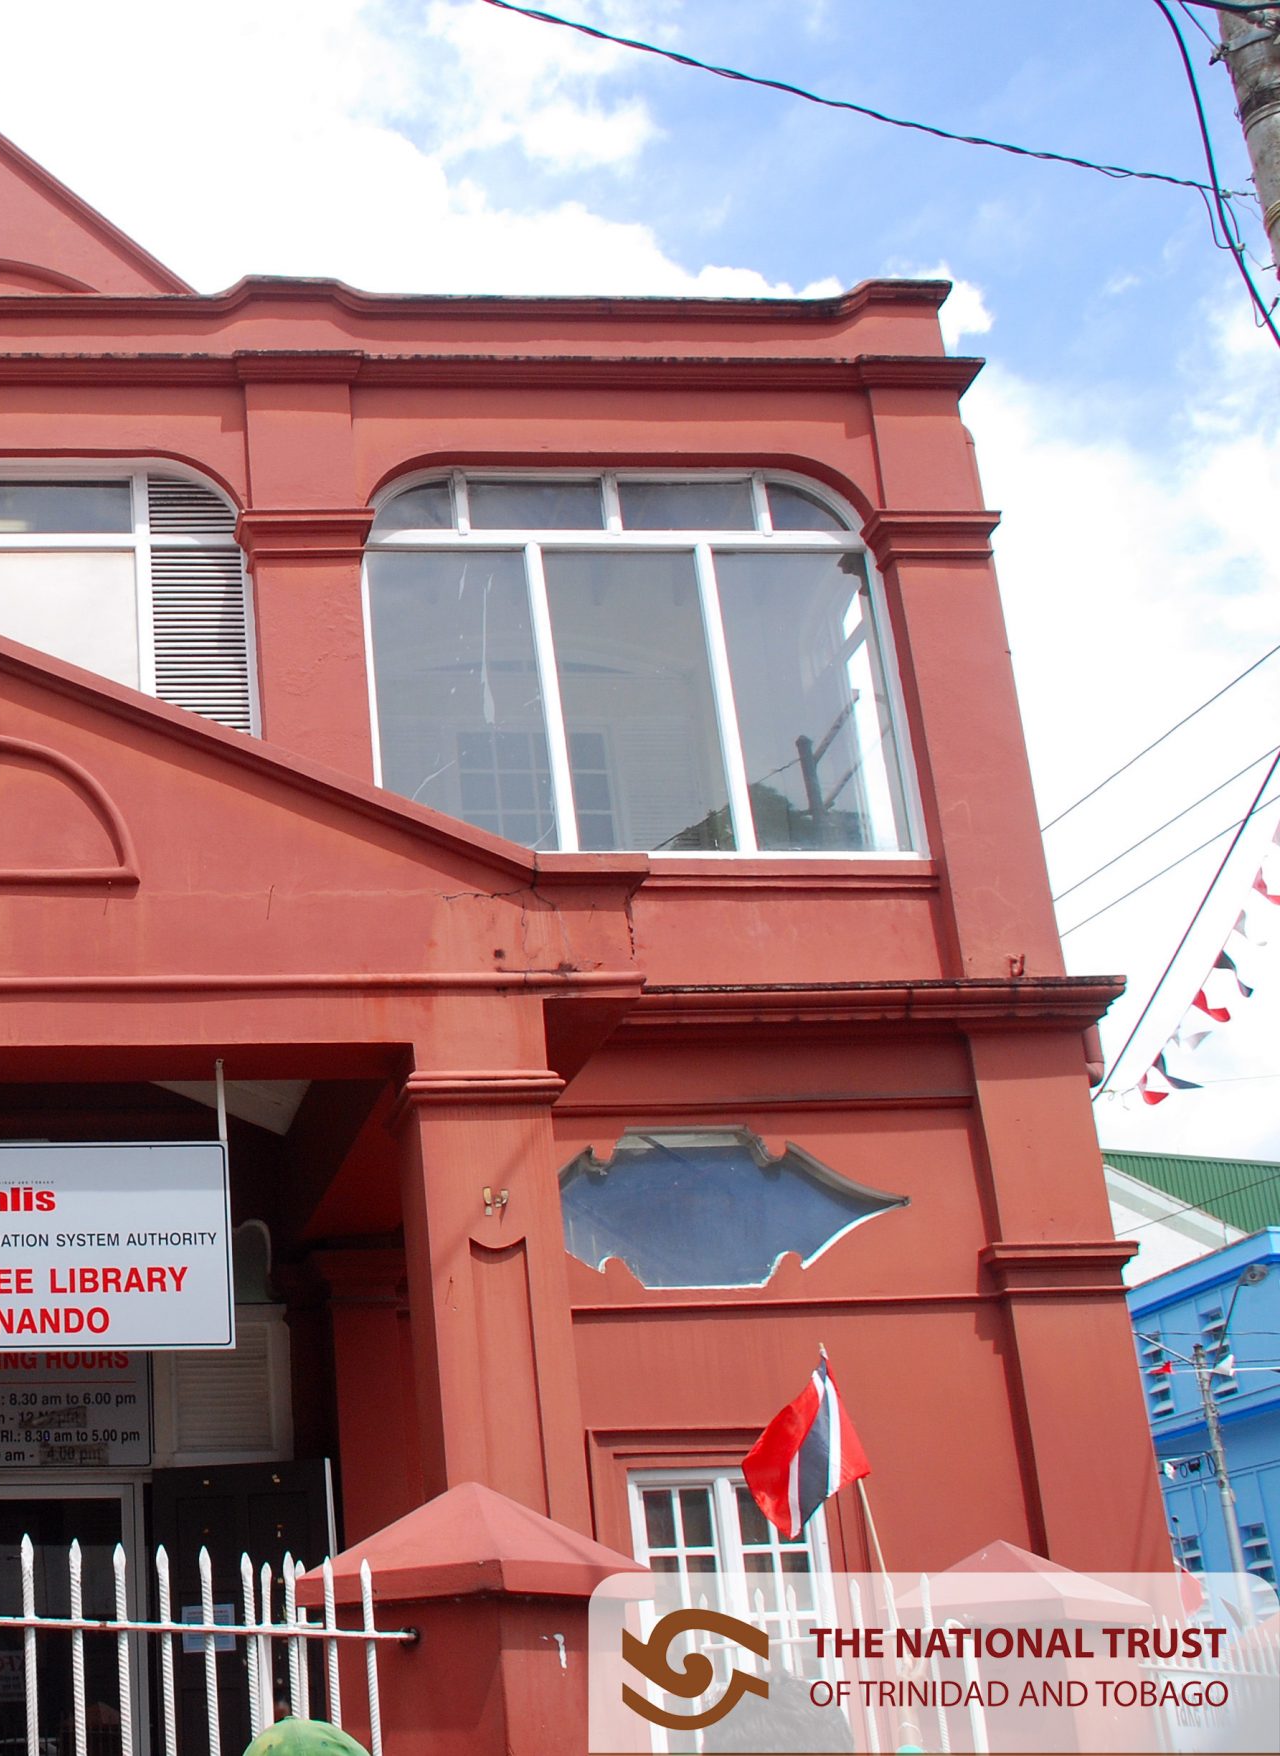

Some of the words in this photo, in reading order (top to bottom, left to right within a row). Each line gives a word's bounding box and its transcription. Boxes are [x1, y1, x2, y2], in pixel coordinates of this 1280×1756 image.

[57, 1234, 119, 1247] SYSTEM
[127, 1233, 216, 1246] AUTHORITY
[50, 1267, 187, 1293] LIBRARY
[46, 1352, 129, 1369] HOURS
[10, 1393, 37, 1405] 8.30
[42, 1396, 61, 1405] am
[66, 1394, 79, 1404] to
[83, 1393, 111, 1404] 6.00
[116, 1395, 136, 1407] pm
[25, 1430, 50, 1442] 8.30
[54, 1433, 72, 1442] am
[77, 1431, 87, 1442] to
[92, 1429, 117, 1442] 5.00
[121, 1433, 140, 1445] pm
[5, 1452, 24, 1461] am
